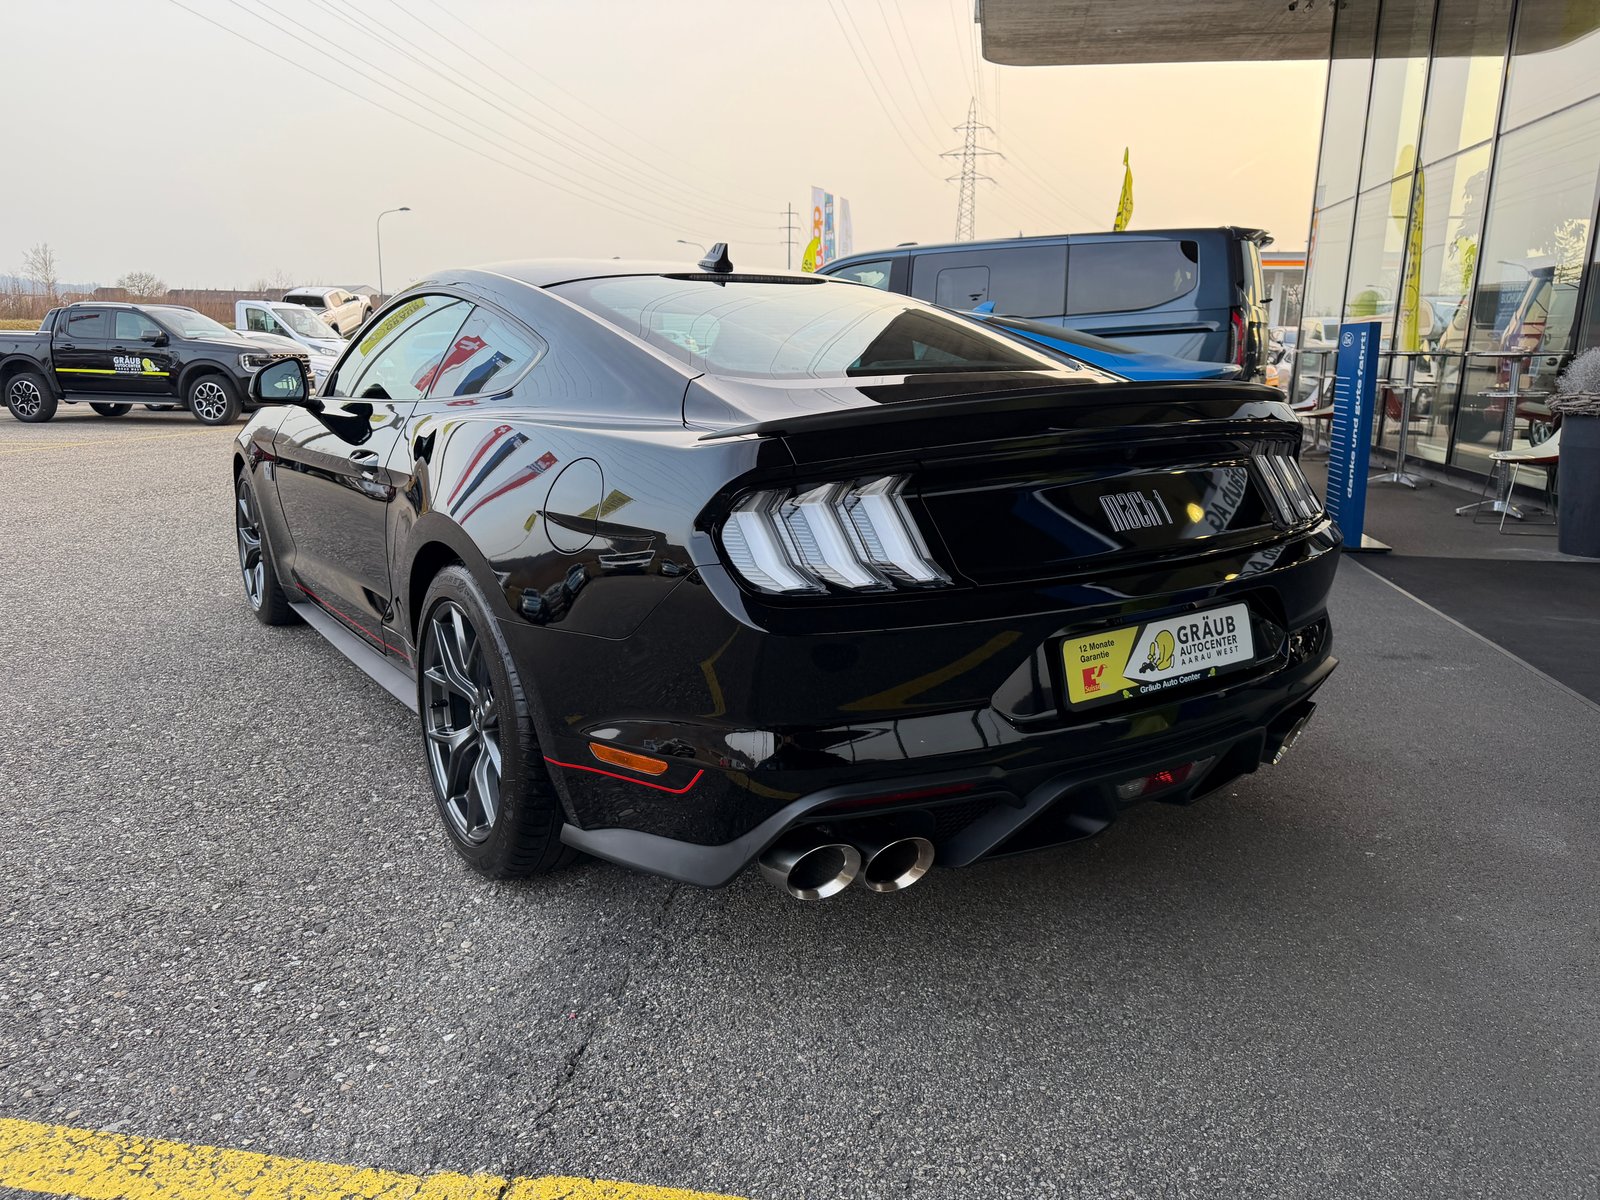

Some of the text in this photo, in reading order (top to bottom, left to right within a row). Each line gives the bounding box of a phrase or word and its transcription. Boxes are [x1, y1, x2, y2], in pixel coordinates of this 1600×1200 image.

[113, 355, 141, 364] GRÄUB
[1347, 331, 1367, 498] danke und gute fahrt!
[1152, 489, 1173, 524] 1
[1177, 615, 1236, 644] GRÄUB
[1079, 639, 1115, 653] 12 Monate
[1180, 634, 1238, 656] AUTOCENTER
[1080, 651, 1110, 663] Garantie
[1181, 646, 1239, 666] AARAU WEST
[1140, 673, 1201, 694] Gräub Auto Center
